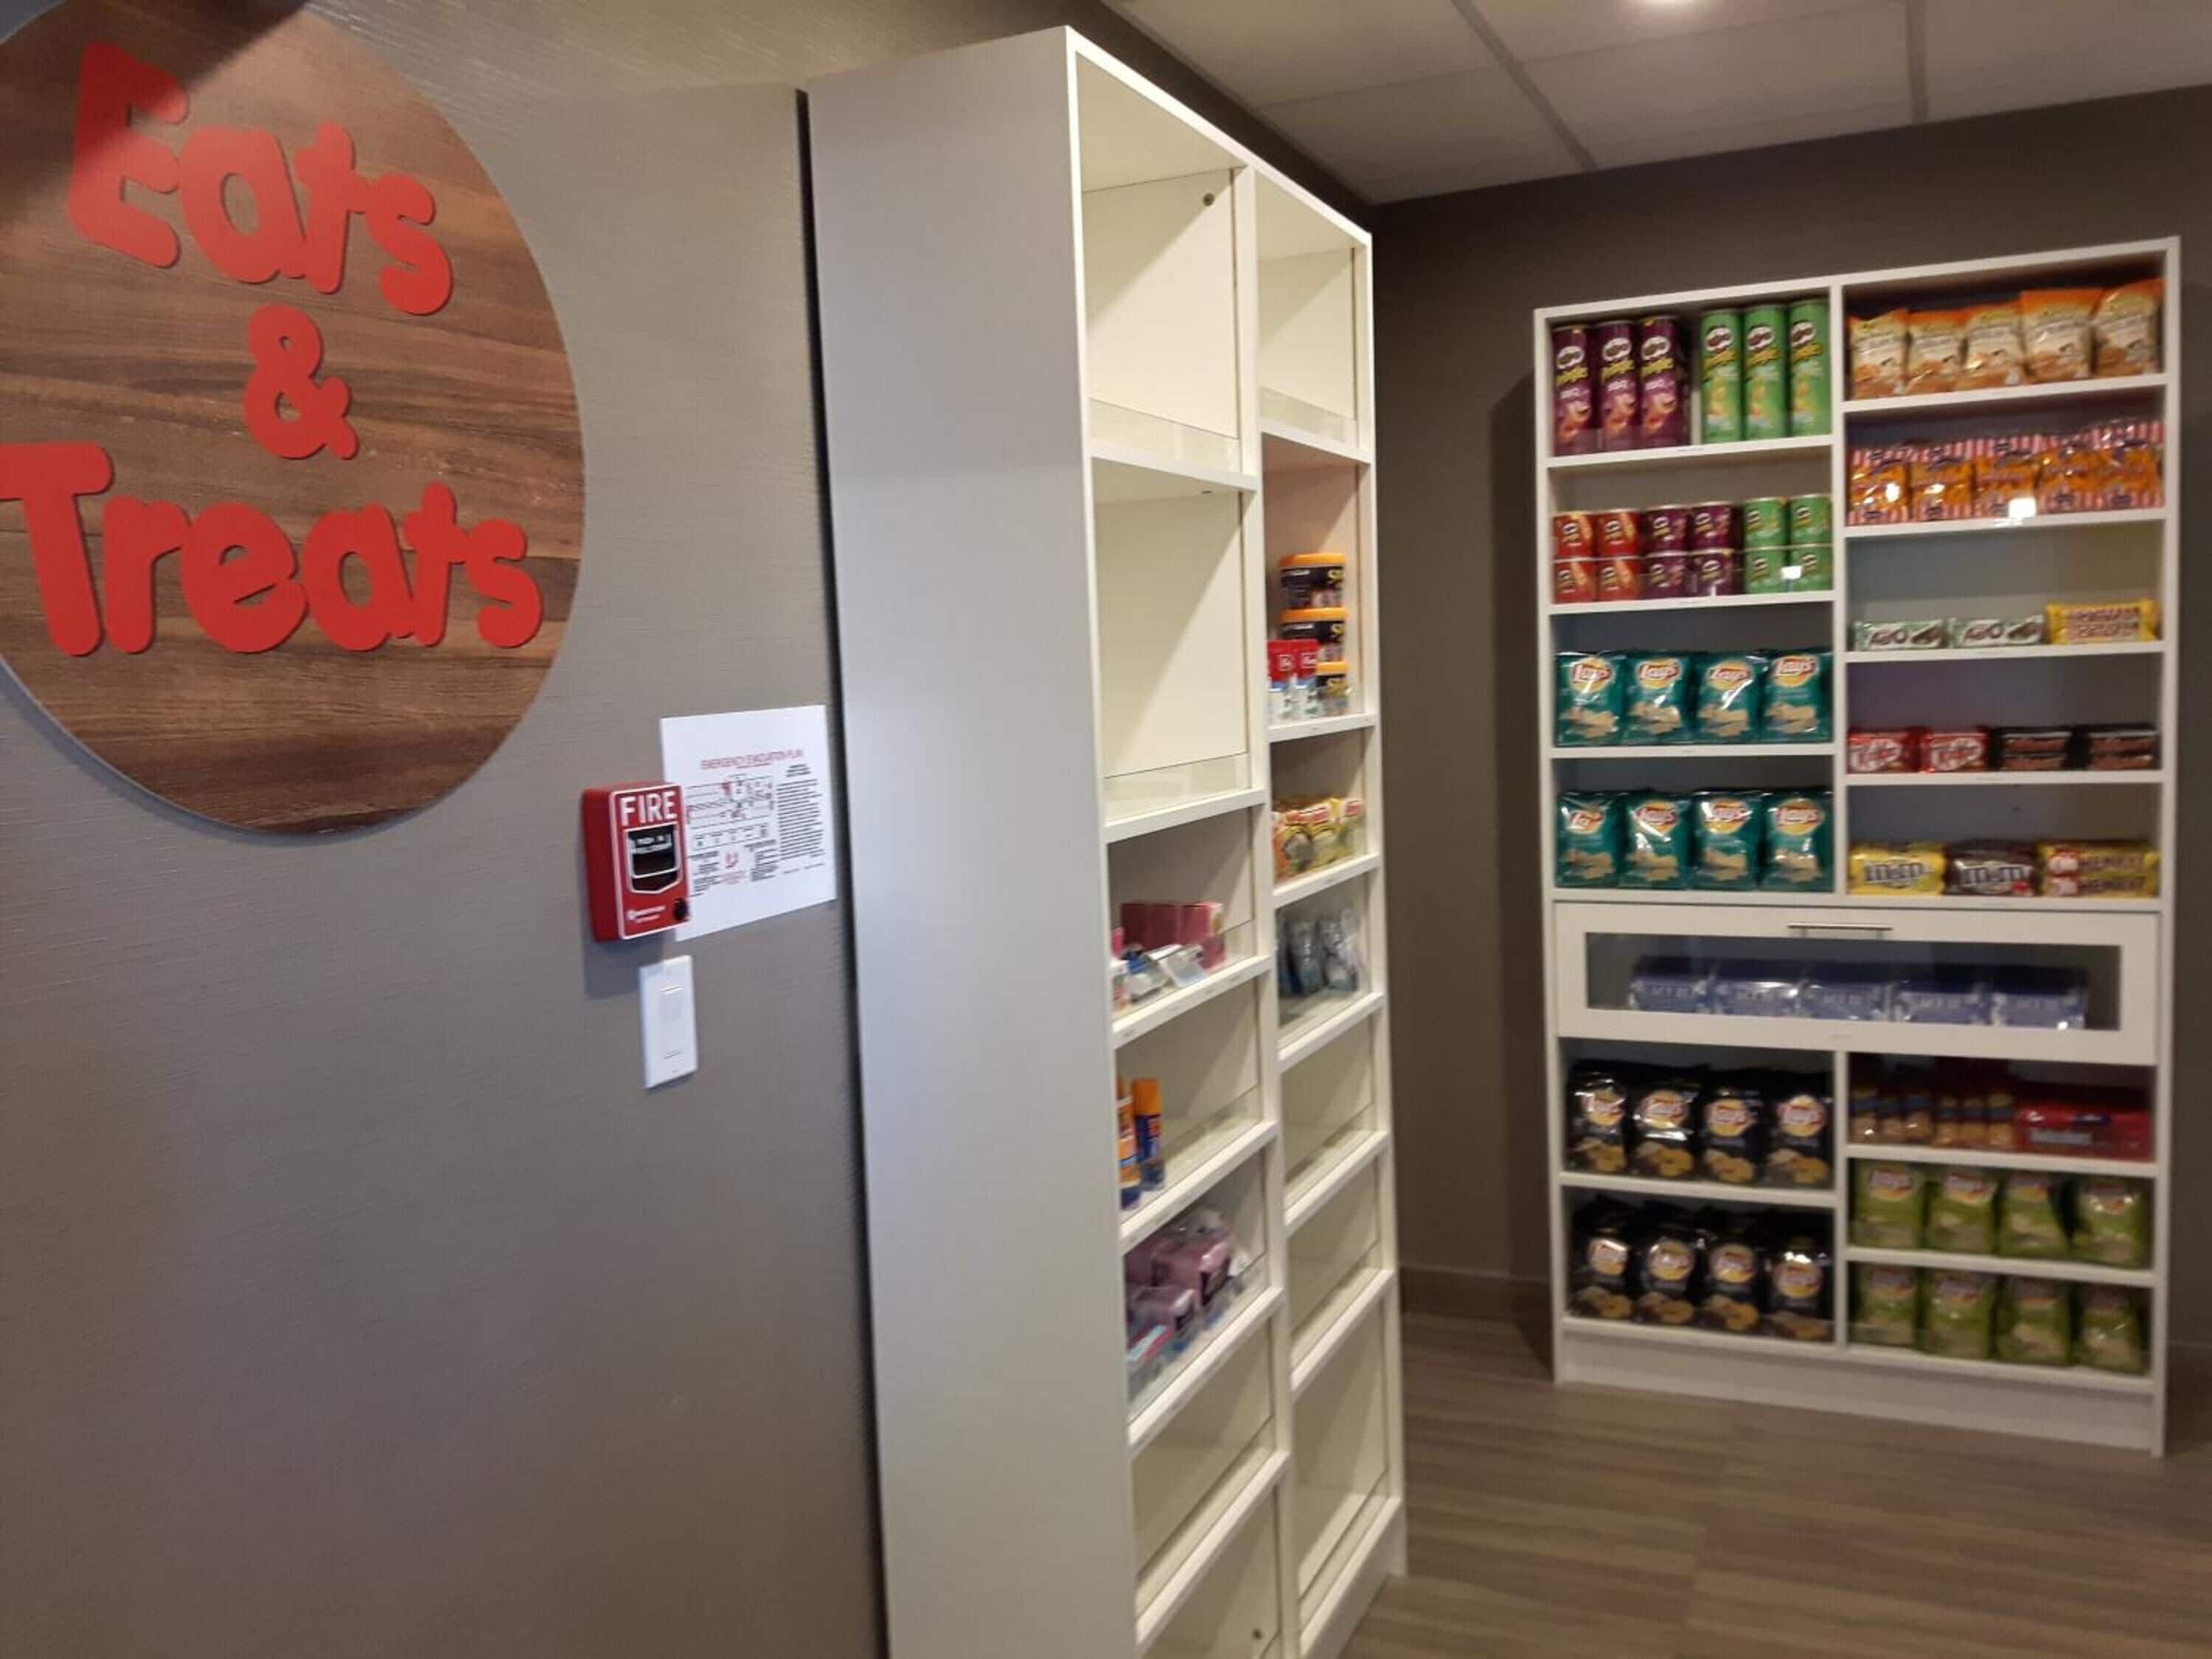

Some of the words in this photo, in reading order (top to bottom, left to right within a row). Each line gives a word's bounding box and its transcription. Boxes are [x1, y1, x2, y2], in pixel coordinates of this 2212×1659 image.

[67, 41, 453, 315] Eats
[243, 301, 360, 460] &
[0, 441, 544, 657] Treats
[619, 790, 678, 827] FIRE
